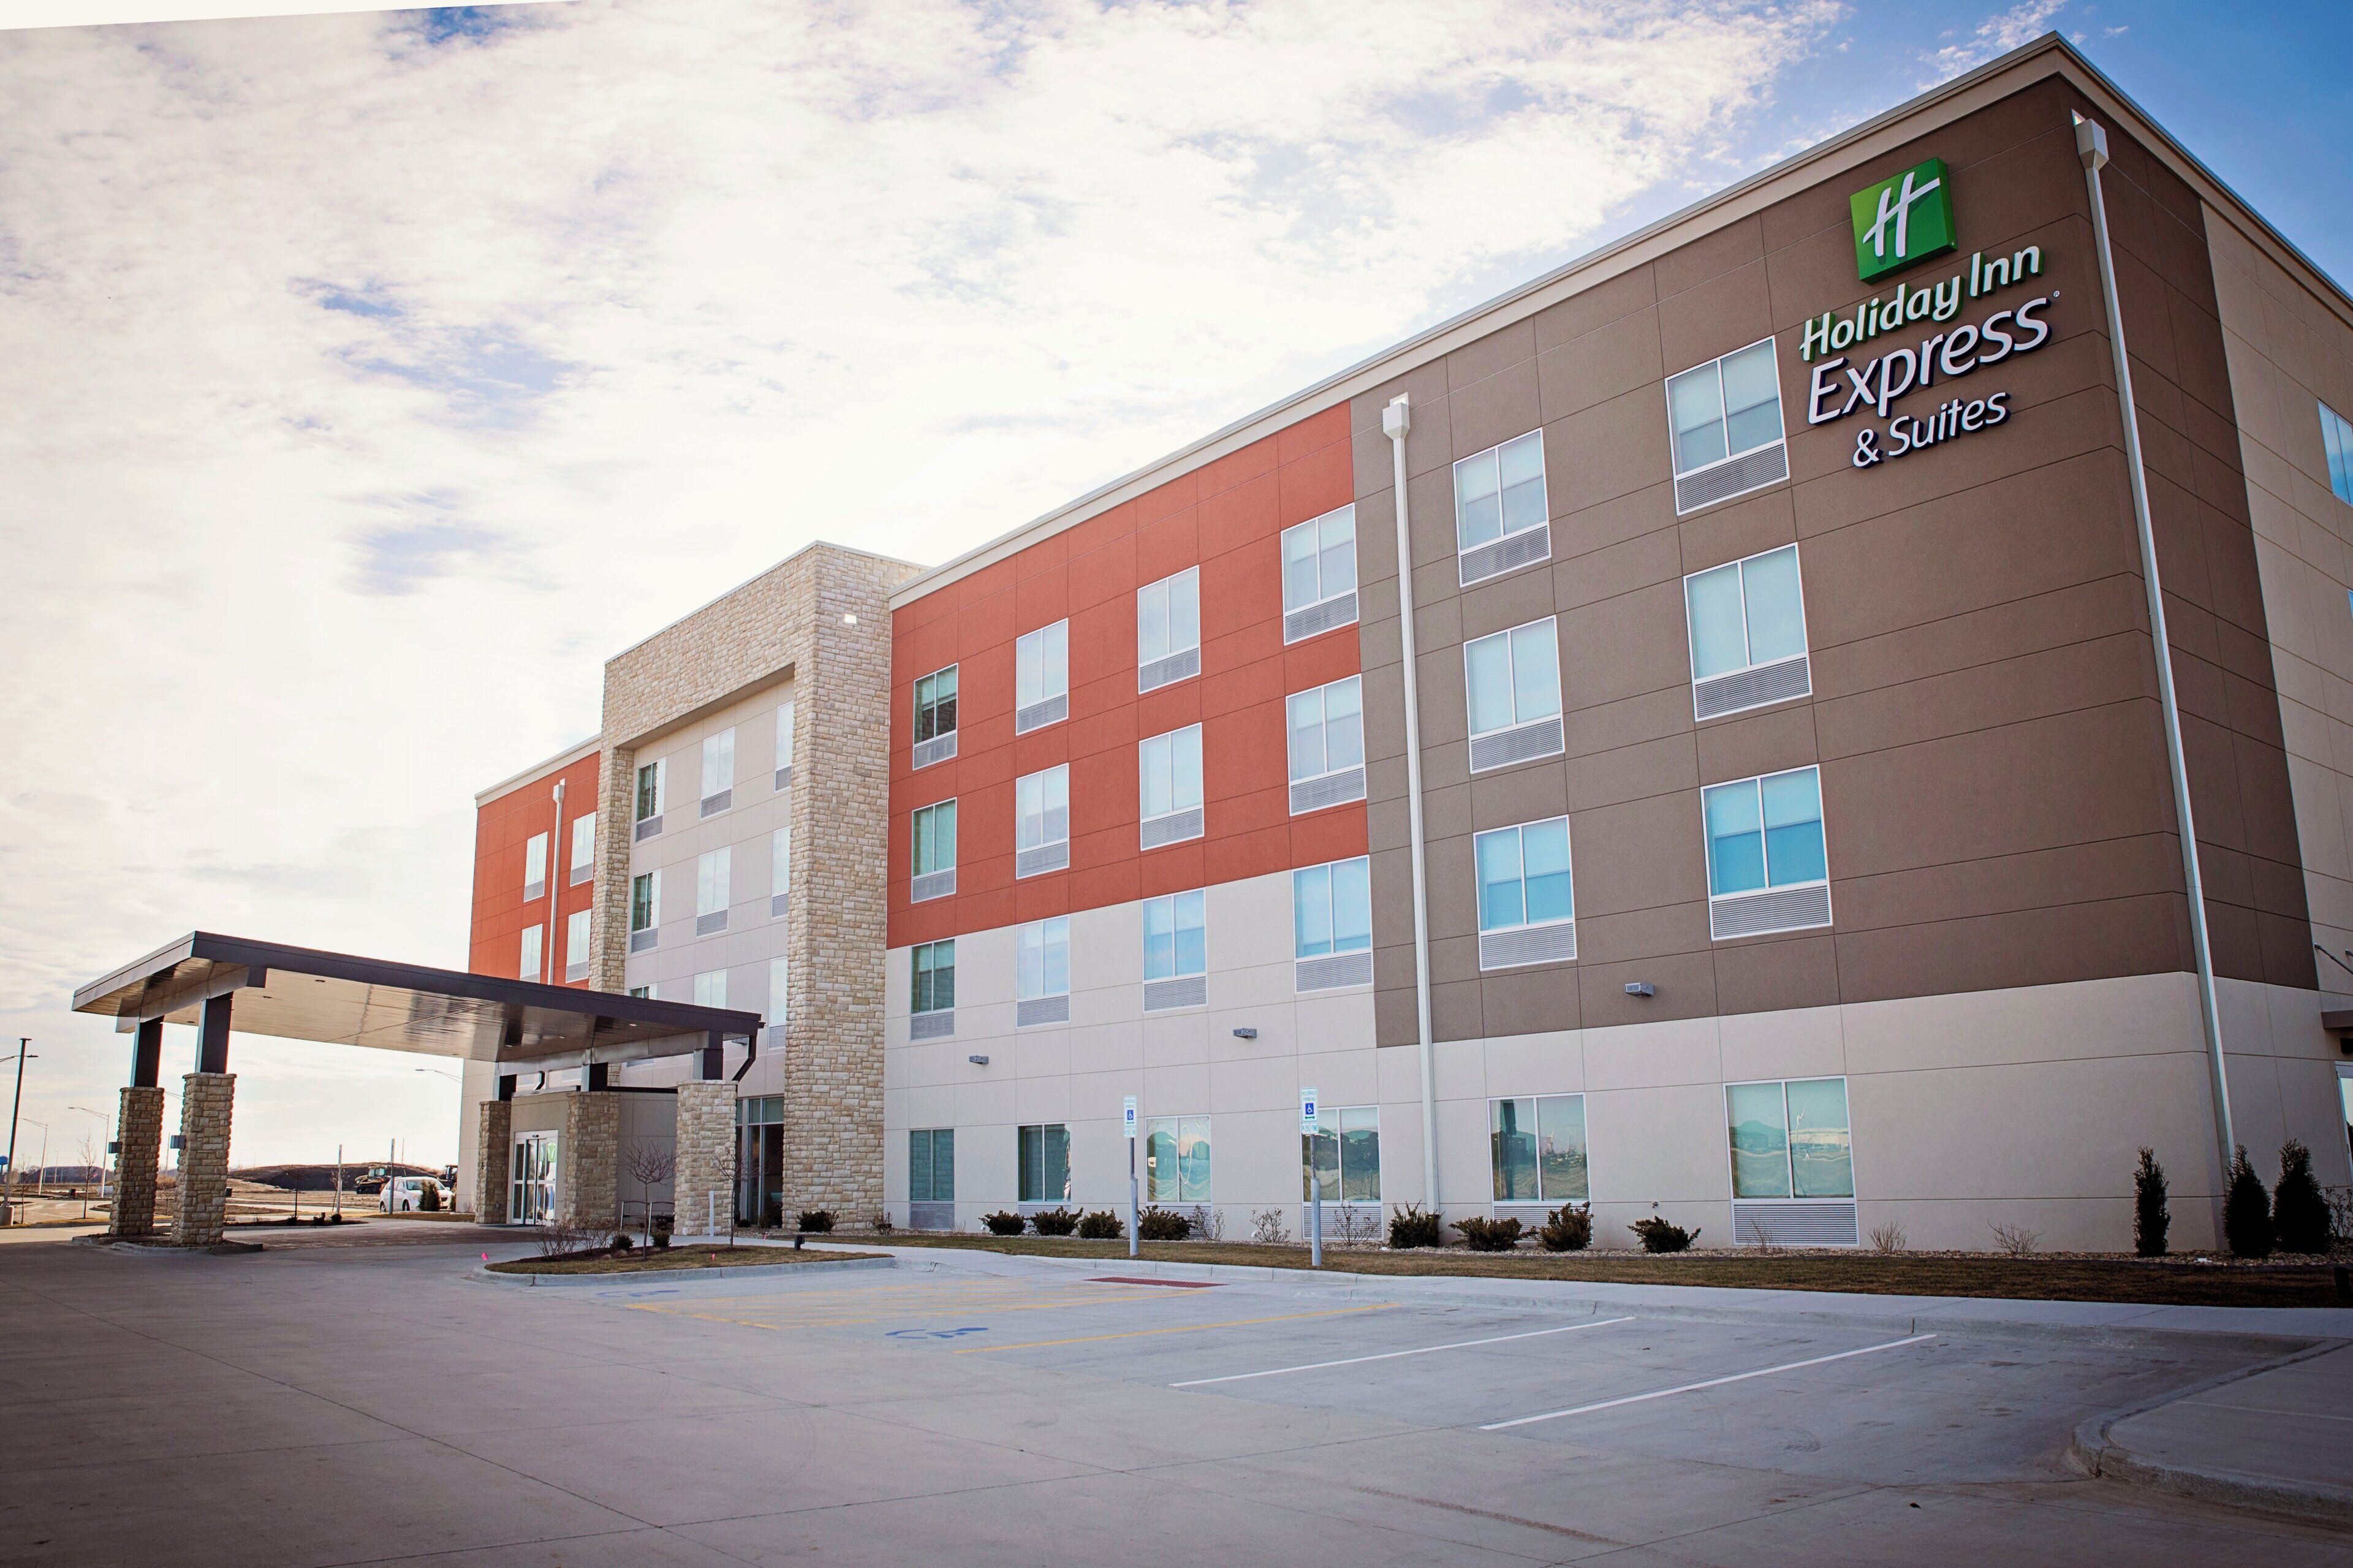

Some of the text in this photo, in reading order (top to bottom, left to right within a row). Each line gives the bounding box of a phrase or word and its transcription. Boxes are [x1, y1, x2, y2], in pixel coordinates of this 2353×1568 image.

[1863, 172, 1940, 257] H
[1799, 245, 2042, 361] Holiday Inn
[1808, 297, 2049, 424] Express
[1852, 392, 2008, 468] & Suites
